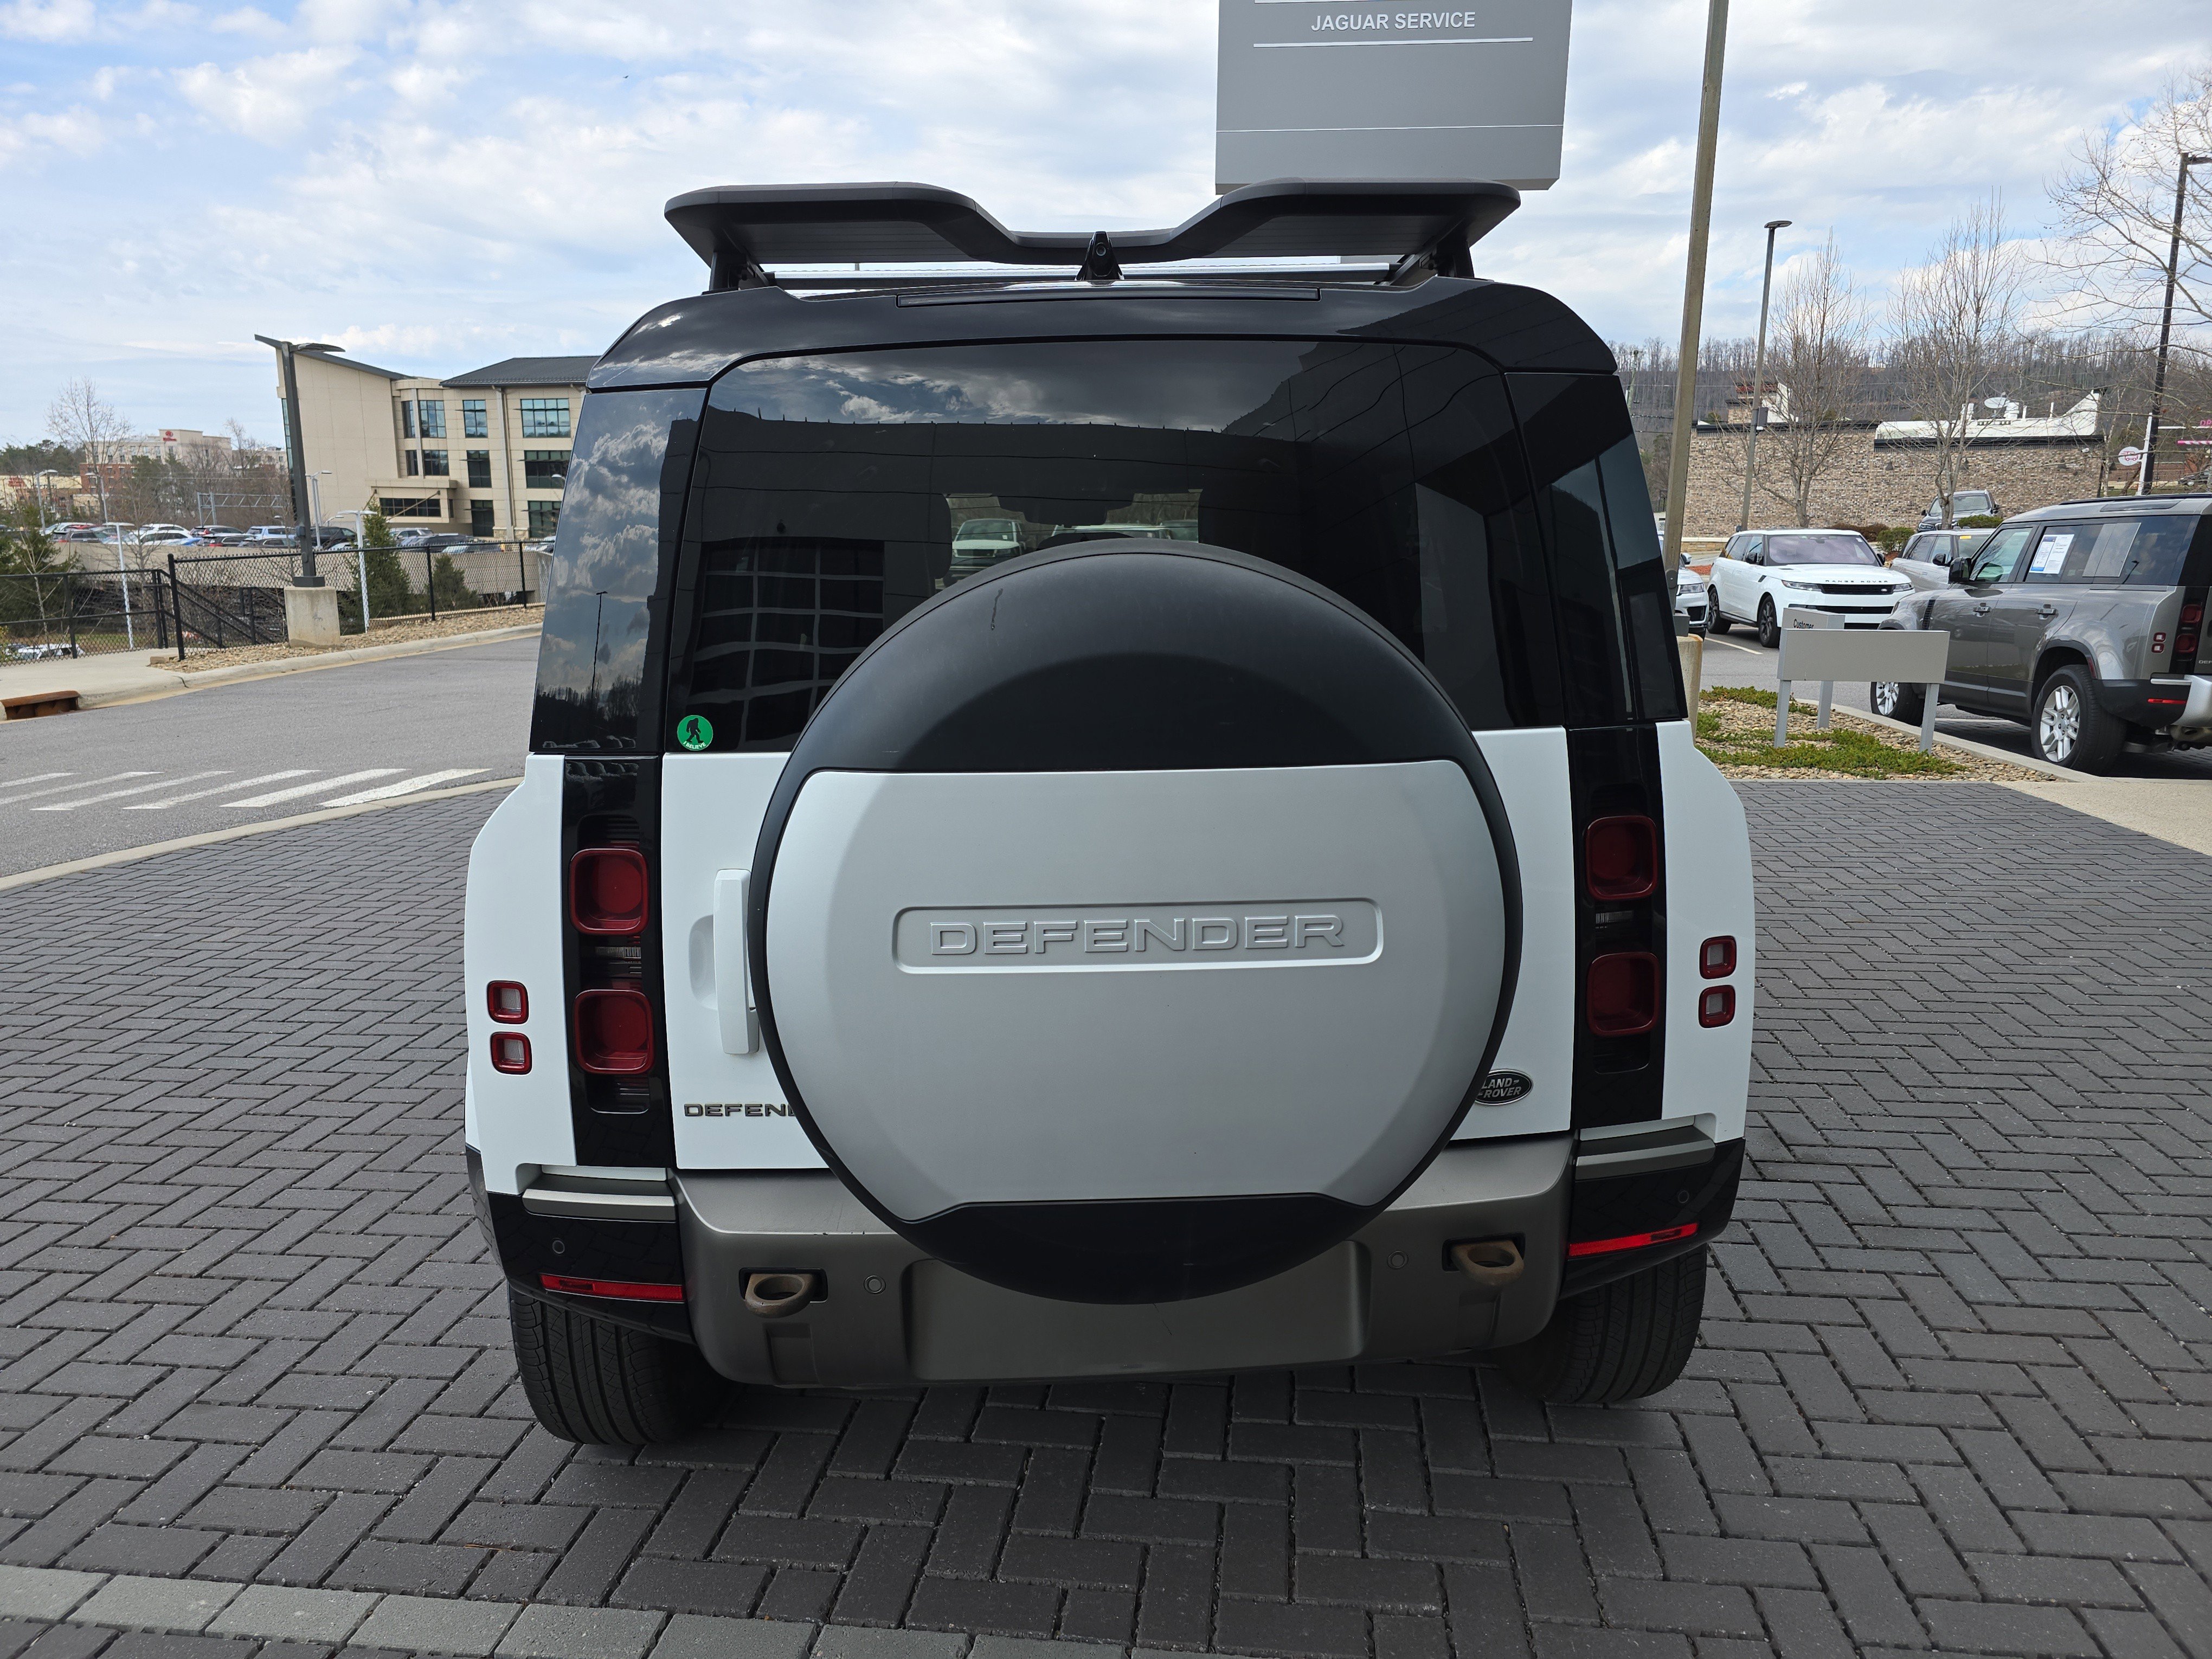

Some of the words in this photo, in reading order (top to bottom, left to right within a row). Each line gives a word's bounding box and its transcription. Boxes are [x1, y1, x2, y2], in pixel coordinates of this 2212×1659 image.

[1311, 14, 1388, 31] JAGUAR
[1394, 12, 1476, 29] SERVICE
[1793, 619, 1814, 629] Customer
[930, 915, 1345, 955] DEFENDER
